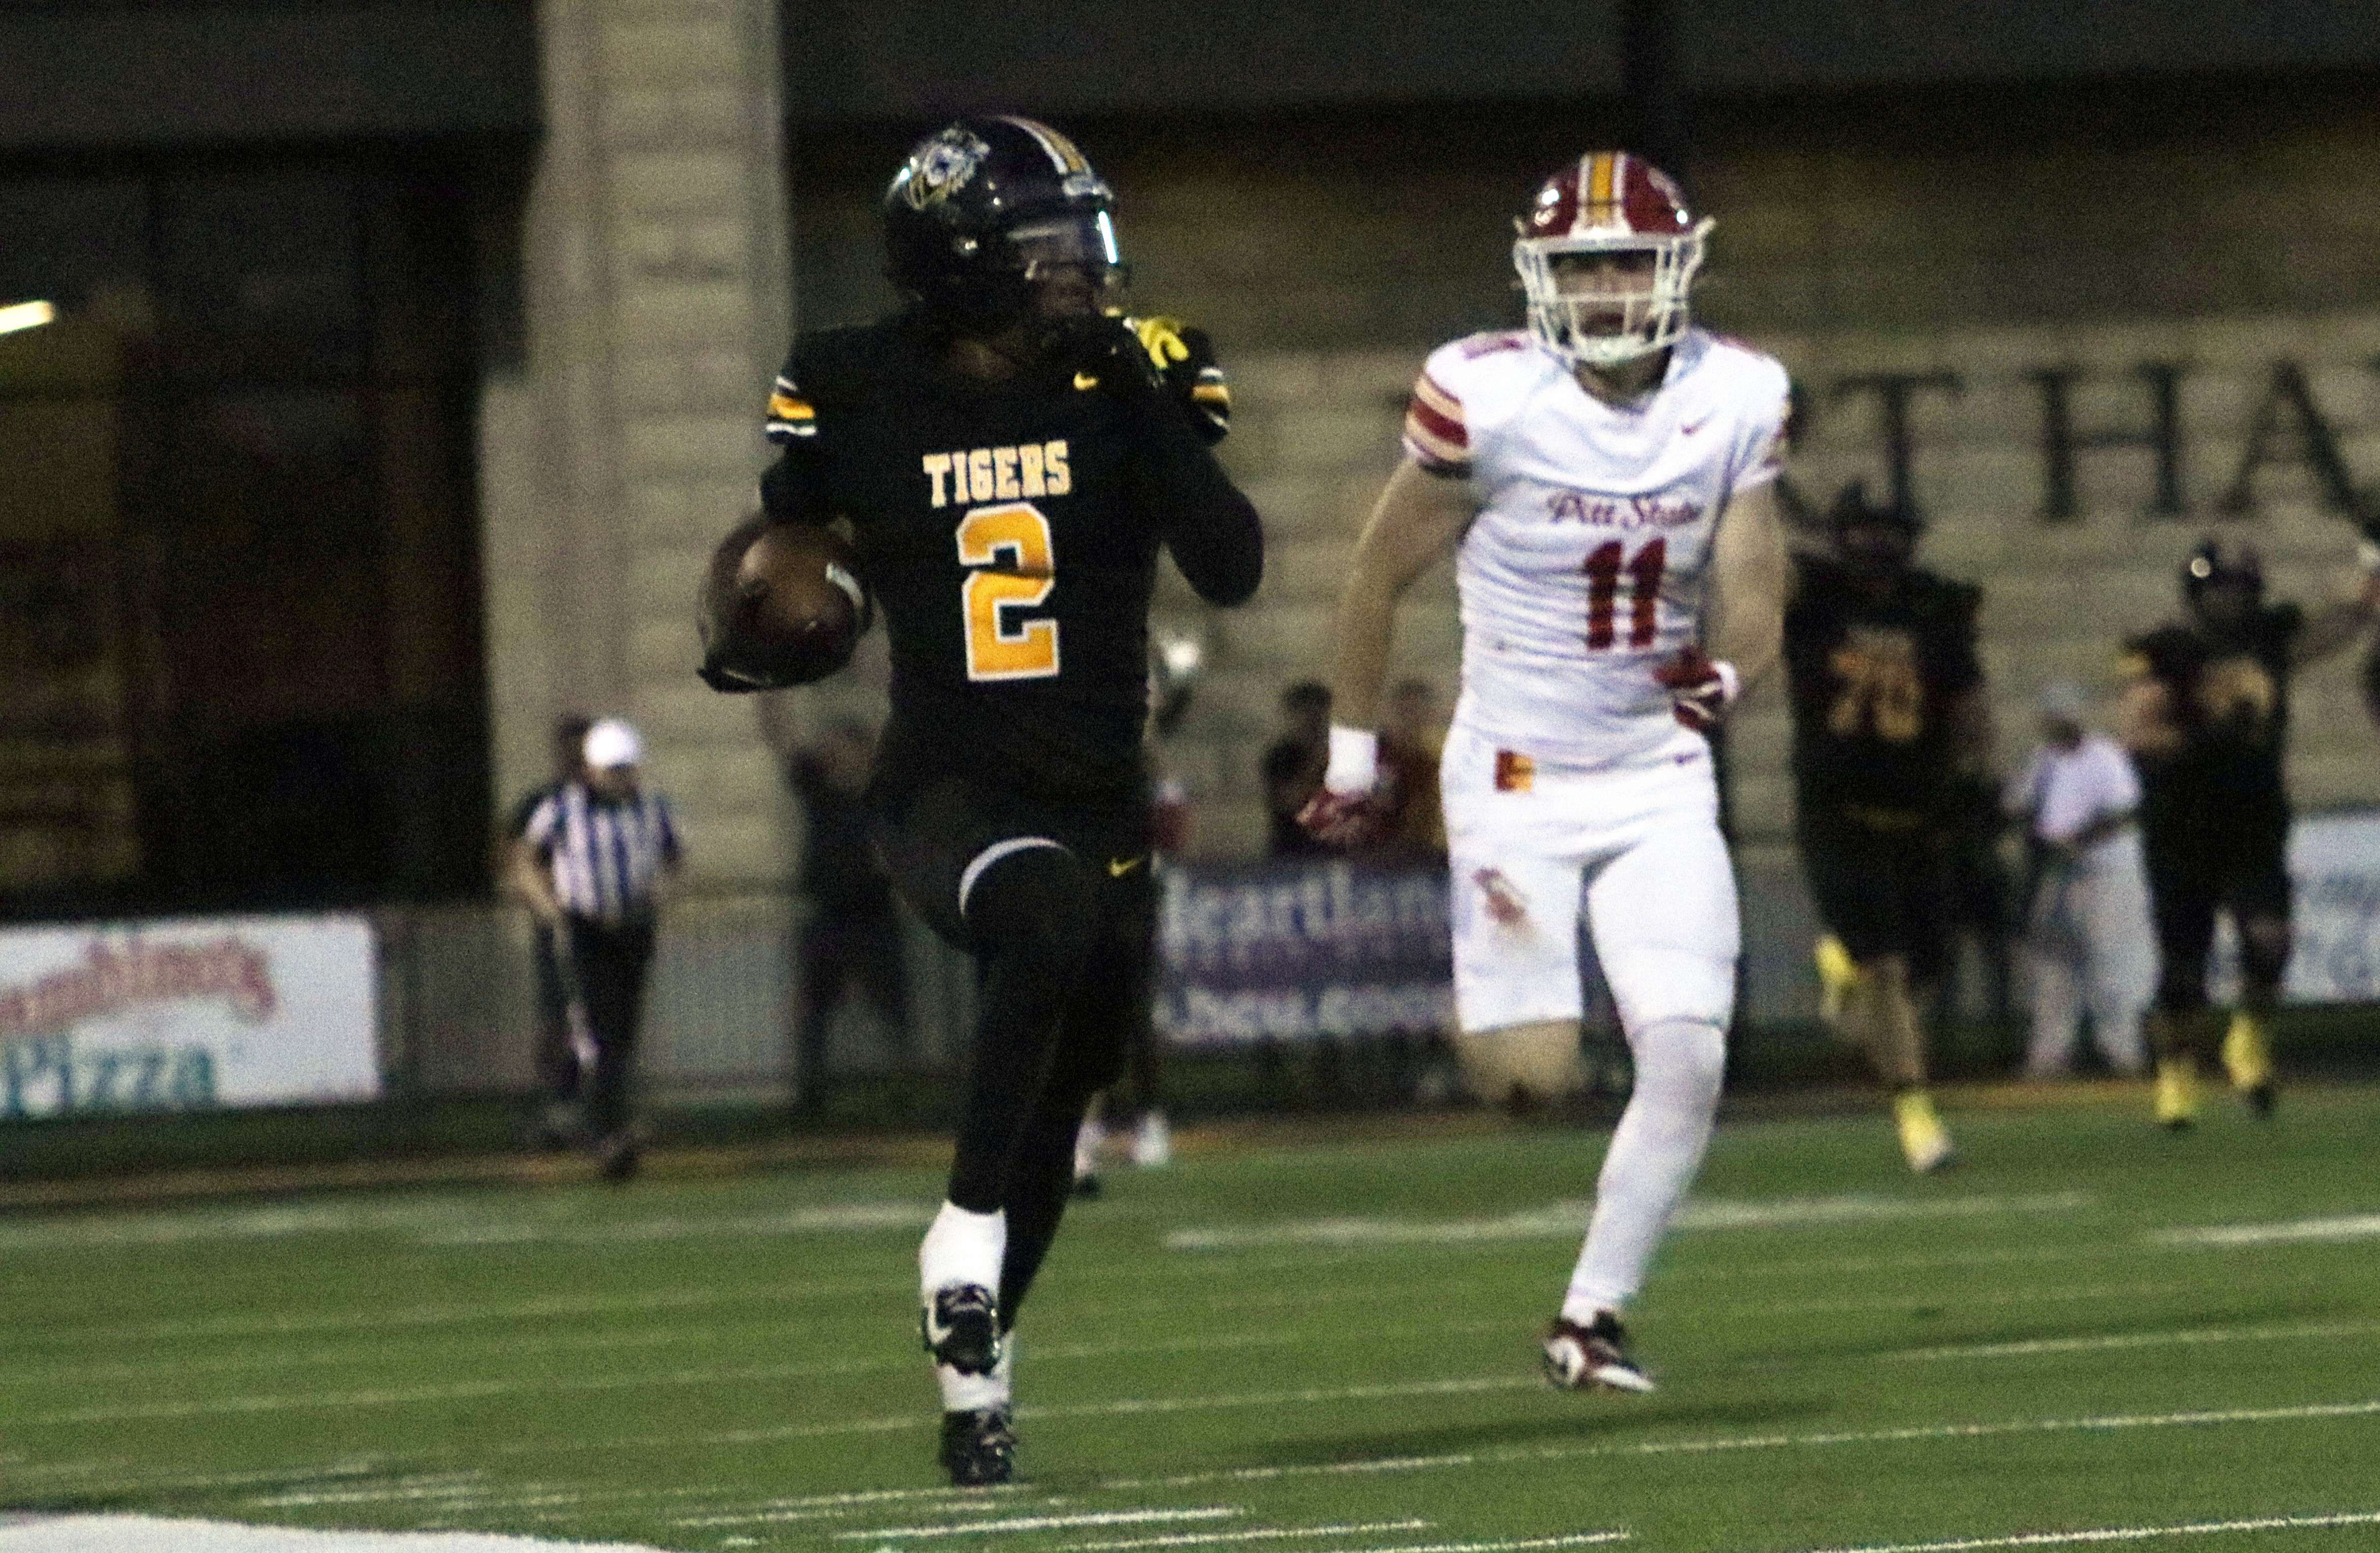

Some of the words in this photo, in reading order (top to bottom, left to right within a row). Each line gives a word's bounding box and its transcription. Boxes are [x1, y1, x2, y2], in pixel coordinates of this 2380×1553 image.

[922, 439, 1071, 508] TIGERS
[956, 503, 1059, 681] 2
[1584, 536, 1667, 652] 11
